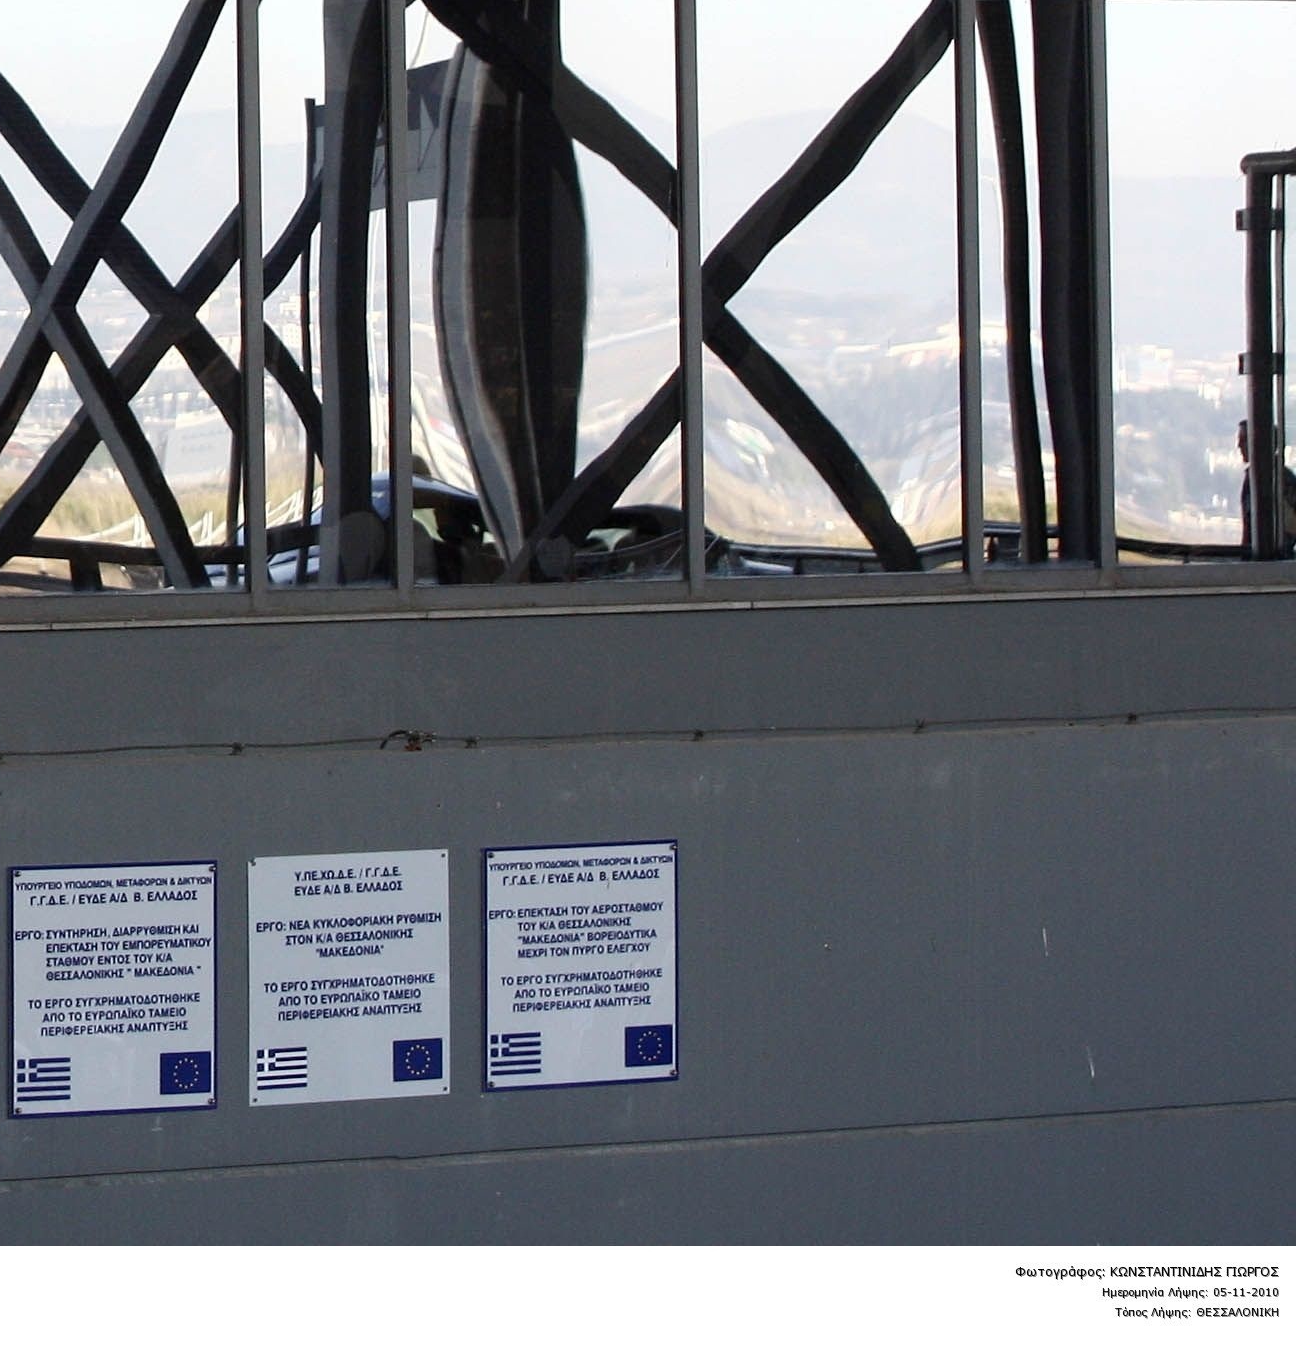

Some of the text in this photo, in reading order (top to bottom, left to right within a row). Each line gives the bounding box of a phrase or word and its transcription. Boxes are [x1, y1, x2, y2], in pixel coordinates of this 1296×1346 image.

[489, 862, 533, 871] ΥΠΟΥΡΓΕΙΟ
[535, 860, 580, 869] ΥΠΟΔΟΜΩΝ,
[583, 857, 631, 867] ΜΕΤΑΦΟΡΩΝ
[640, 855, 673, 864] ΔΙΚΤΥΩΝ
[365, 867, 401, 878] Γ.Γ.Δ.Ε.
[503, 875, 539, 886] Γ.Γ.Δ.Ε.
[548, 873, 574, 883] ΕΥΔΕ
[577, 872, 594, 882] Α/Δ
[599, 872, 608, 881] Β.
[612, 869, 660, 880] ΕΛΛΑΔΟΣ
[15, 882, 62, 891] ΥΠΟΥΡΓΕΙΟ
[65, 880, 113, 889] ΥΠΟΔΟΜΩΝ,
[116, 878, 168, 887] ΜΕΤΑΦΟΡΩΝ
[177, 877, 212, 885] ΔΙΚΤΥΩΝ
[295, 881, 403, 896] ΕΥΔΕ Α/Δ Β. ΕΛΛΑΔΟΣ
[30, 895, 69, 906] Γ.Γ.Δ.Ε.
[79, 894, 106, 904] ΕΥΔΕ
[109, 893, 128, 903] Α/Δ
[134, 892, 144, 902] Β.
[147, 890, 198, 902] ΕΛΛΑΔΟΣ
[489, 902, 663, 920] ΕΡΓΟ: ΕΠΕΚΤΑΣΗ ΤΟΥ ΑΕΡΟΣΤΑΘΜΟΥ
[256, 913, 441, 932] ΕΡΓΟ: ΝΕΑ ΚΥΚΛΟΦΟΡΙΑΚΗ ΡΥΘΜΙΣΗ
[518, 917, 631, 931] ΤΟΥ Κ/Α ΘΕΣΣΑΛΟΝΙΚΗΣ
[15, 931, 44, 940] ΕΡΓΟ:
[113, 925, 180, 936] ΔΙΑΡΡΥΘΜΙΣΗ
[183, 925, 199, 934] ΚΑΙ
[285, 928, 414, 945] ΣΤΟΝ Κ/Α ΘΕΣΣΑΛΟΝΙΚΗΣ
[518, 930, 657, 945] "ΜΑΚΕΔΟΝΙΑ" ΒΟΡΕΙΟΔΥΤΙΚΑ
[46, 938, 211, 953] ΕΠΕΚΤΑΣΗ ΤΟΥ ΕΜΠΟΡΕΥΜΑΤΙΚΟΥ
[316, 945, 384, 958] "ΜΑΚΕΔΟΝΙΑ"
[518, 943, 651, 958] ΜΕΧΡΙ ΤΟΝ ΠΥΡΓΟ ΕΛΕΓΧΟΥ
[46, 953, 173, 967] ΣΤΑΘΜΟΥ ΕΝΤΟΣ ΤΟΥ Κ/Α
[46, 968, 124, 981] ΘΕΣΣΑΛΟΝΙΚΗΣ
[501, 968, 663, 986] ΤΟ ΕΡΓΟ ΣΥΓΧΡΗΜΑΤΟΔΟΤΗΘΗΚΕ
[264, 973, 434, 993] ΤΟ ΕΡΓΟ ΣΥΓΧΡΗΜΑΤΟΔΟΤΗΘΗΚΕ
[515, 982, 650, 999] ΑΠΟ ΤΟ ΕΥΡΩΠΑΪΚΟ ΤΑΜΕΙΟ
[28, 993, 200, 1009] ΤΟ ΕΡΓΟ ΣΥΓΧΡΗΜΑΤΟΔΟΤΗΘΗΚΕ
[279, 989, 421, 1007] ΑΠΟ ΤΟ ΕΥΡΩΠΑΪΚΟ ΤΑΜΕΙΟ
[513, 996, 651, 1012] ΠΕΡΙΦΕΡΕΙΑΚΗΣ ΑΝΑΠΤΥΞΗΣ
[43, 1007, 186, 1022] ΑΠΟ ΤΟ ΕΥΡΩΠΑΪΚΟ ΤΑΜΕΙΟ
[278, 1003, 422, 1021] ΠΕΡΙΦΕΡΕΙΑΚΗΣ ΑΝΑΠΤΥΞΗΣ
[41, 1021, 188, 1037] ΠΕΡΙΦΕΡΕΙΑΚΗΣ ΑΝΑΠΤΥΞΗΣ
